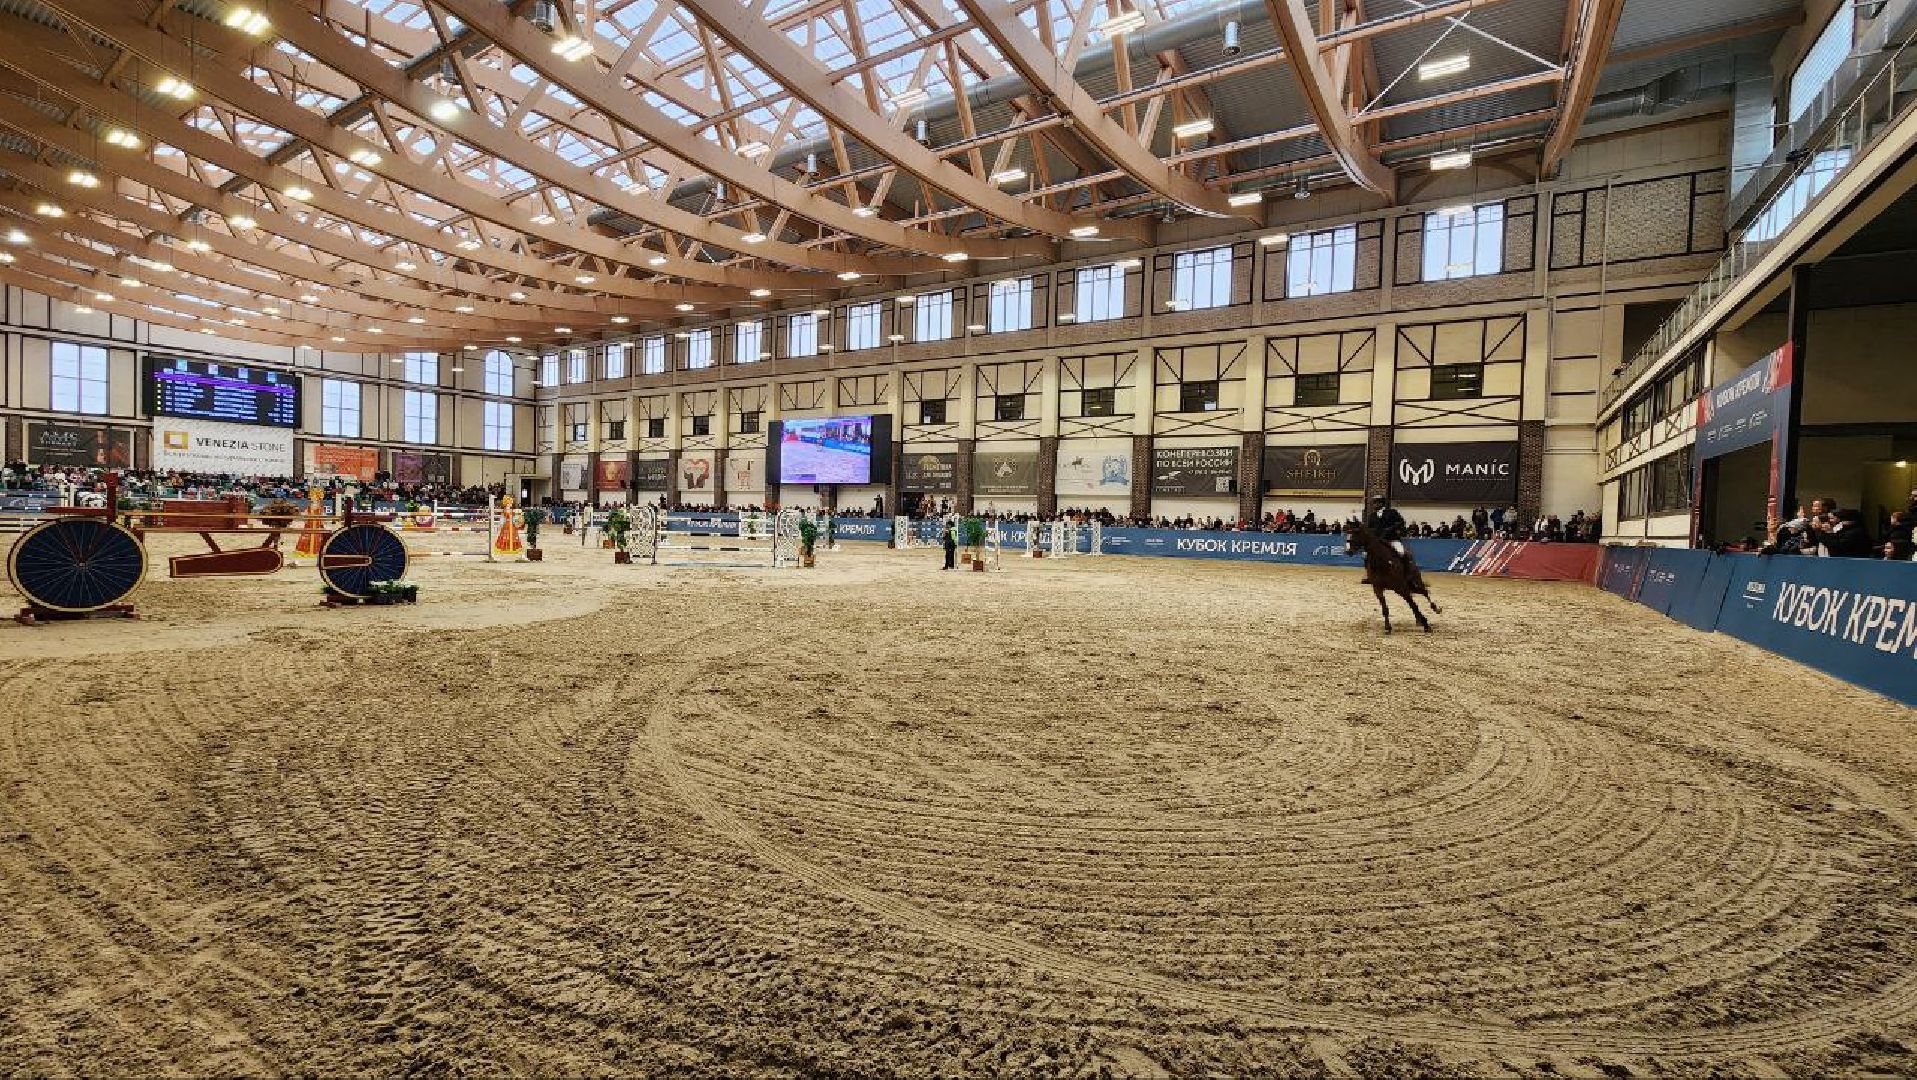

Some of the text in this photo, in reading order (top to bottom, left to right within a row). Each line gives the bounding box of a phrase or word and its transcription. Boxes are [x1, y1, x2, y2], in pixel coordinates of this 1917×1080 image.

[196, 437, 286, 453] VENEZIA STONE
[1156, 448, 1233, 459] КОНЕПЕРЕВОЗКИ
[1156, 460, 1170, 468] ПО
[1195, 458, 1233, 468] РОССИИ
[1445, 458, 1510, 475] MANÍC
[839, 523, 875, 535] КРЕМЛЯ
[1177, 538, 1226, 552] КУБОК
[1231, 540, 1298, 556] КРЕМЛЯ
[1772, 581, 1849, 636] КУБОК
